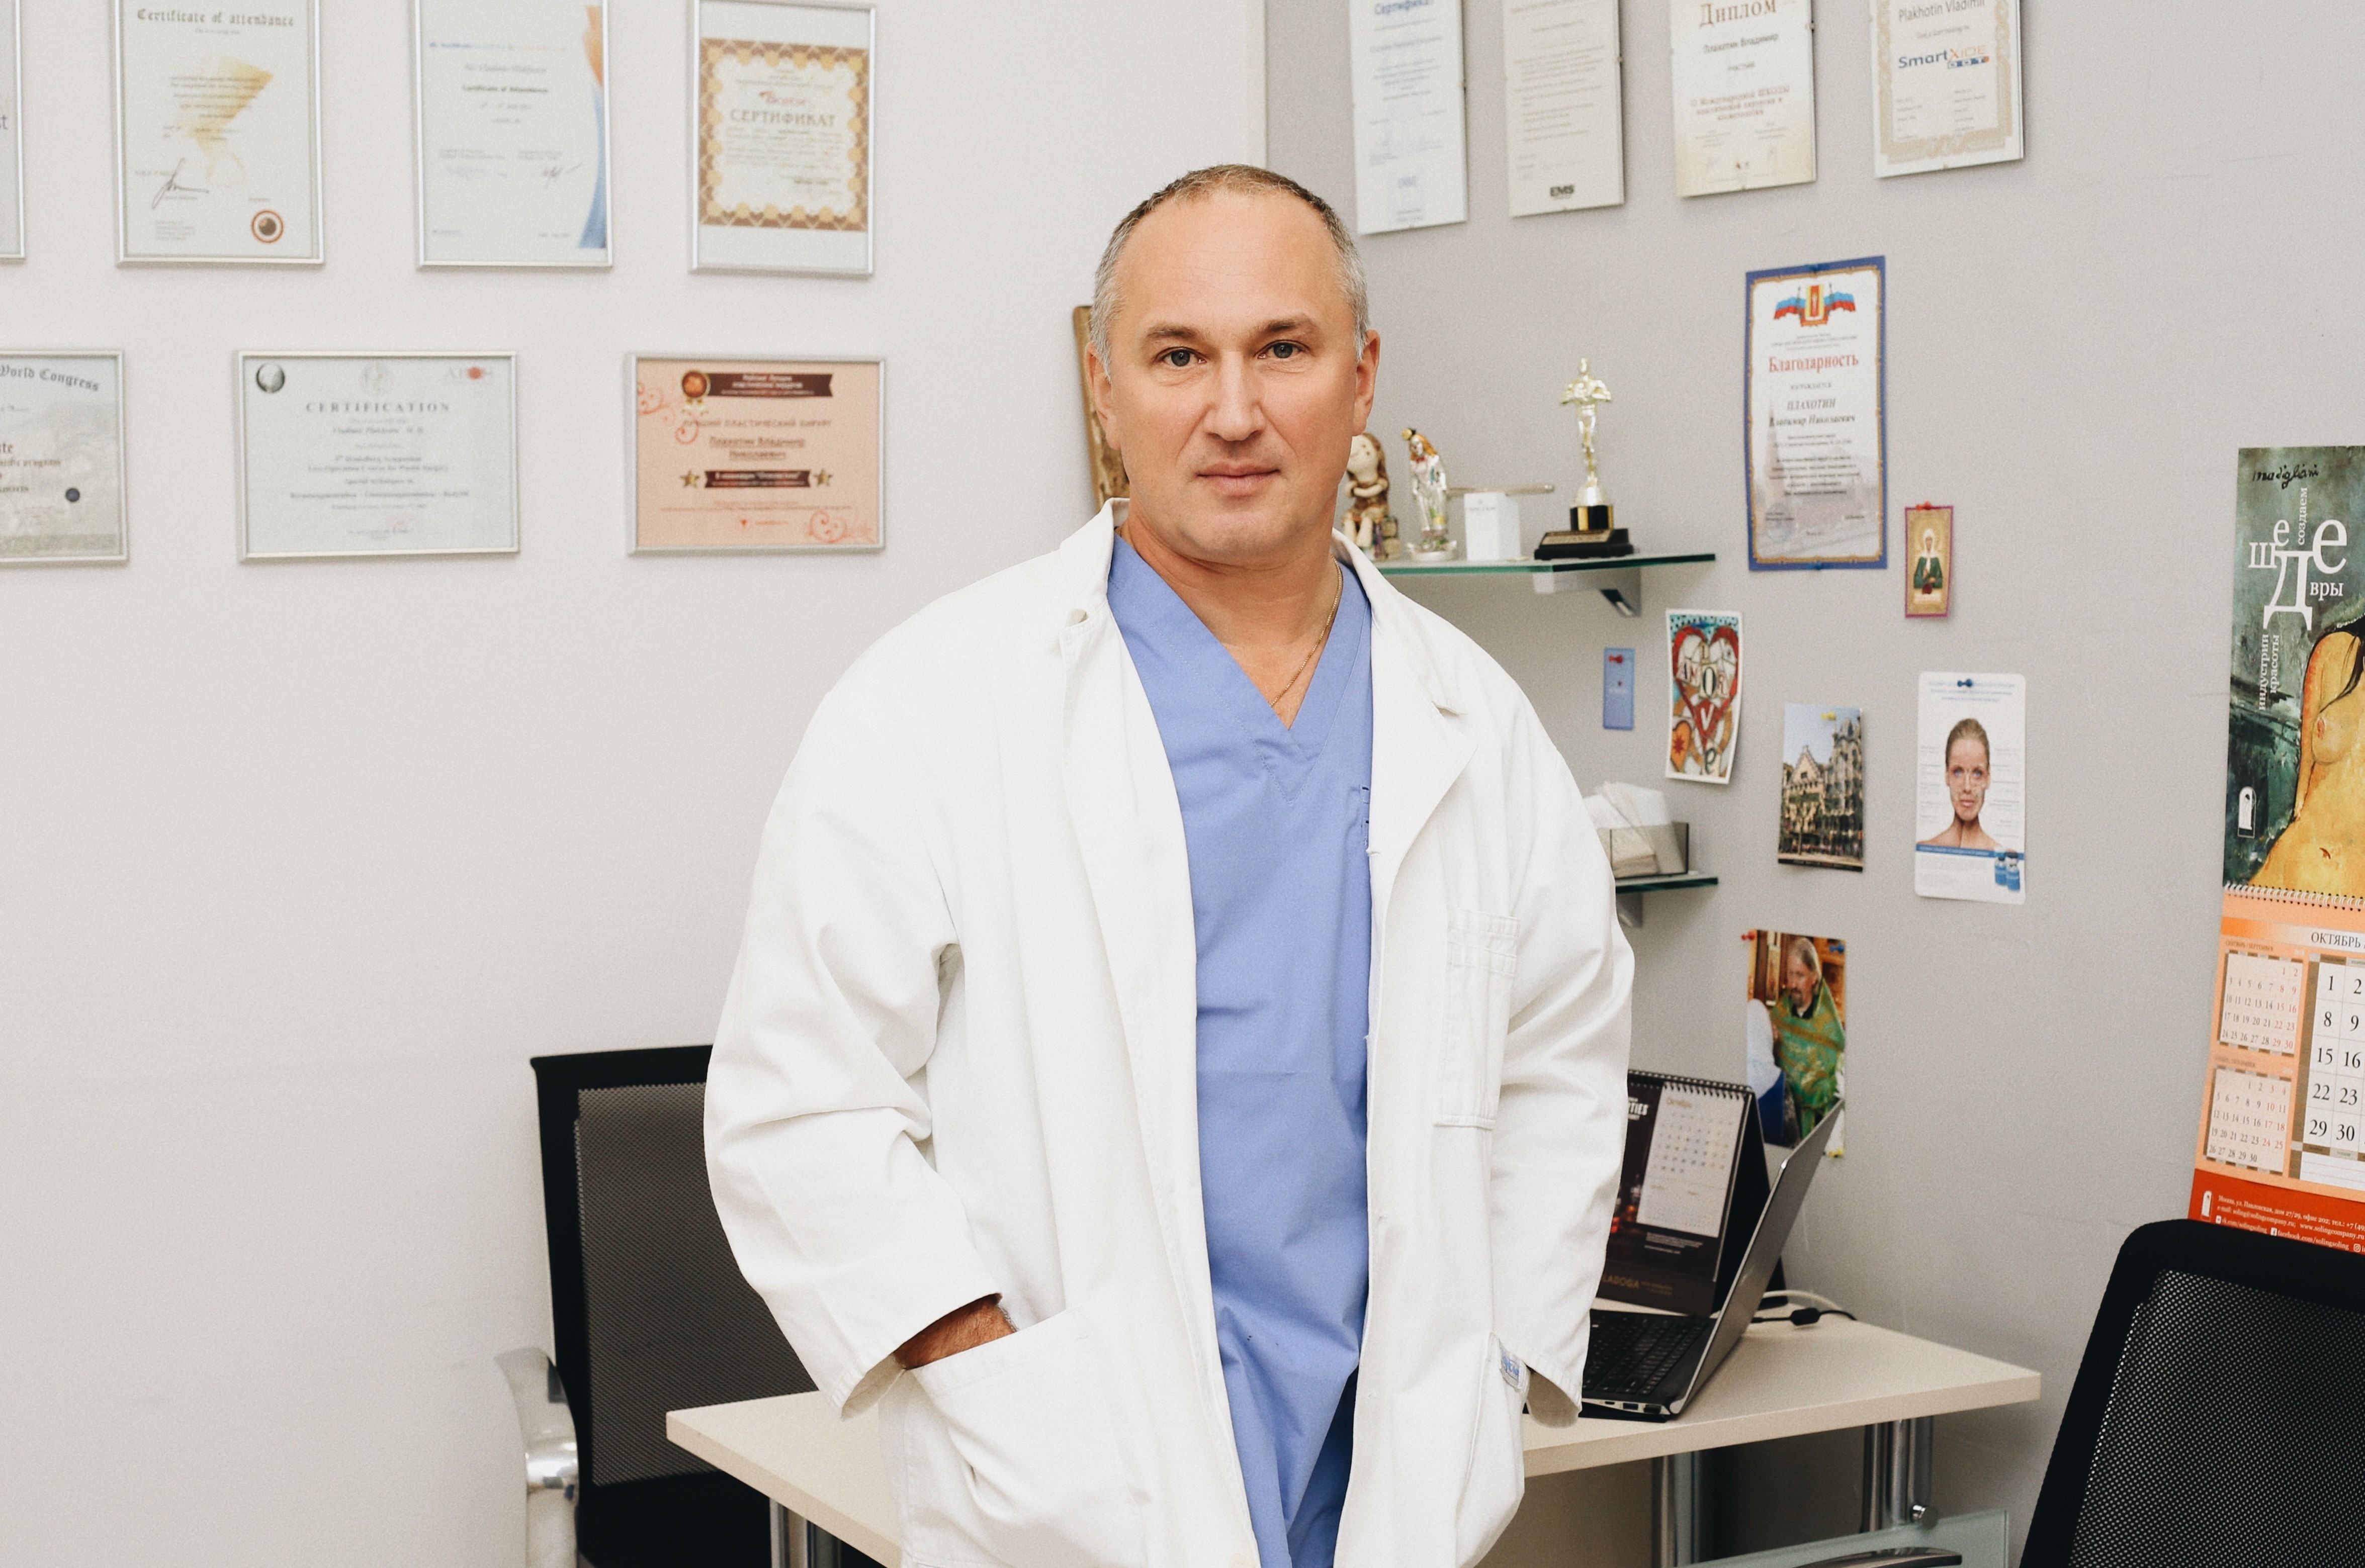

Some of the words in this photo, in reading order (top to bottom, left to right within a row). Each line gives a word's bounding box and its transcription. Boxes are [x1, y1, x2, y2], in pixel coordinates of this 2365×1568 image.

[137, 8, 205, 22] Certificate
[212, 11, 222, 23] of
[230, 14, 294, 26] attendance
[1699, 0, 1776, 29] Диплом
[1899, 5, 1943, 21] Plakhotin
[1946, 0, 1985, 13] Vladimir
[730, 109, 836, 126] СЕРТИФИКАТ
[1550, 184, 1574, 197] EMS
[1769, 354, 1859, 374] Благодарность
[39, 368, 100, 391] Congress
[306, 403, 450, 413] CERTIFICATION
[2298, 487, 2308, 545] создаем
[2259, 634, 2269, 710] индустрии
[2270, 634, 2280, 694] красоты
[2311, 932, 2360, 948] ОКТЯБРЬ
[2294, 969, 2298, 977] 2
[2280, 985, 2284, 993] 8
[2292, 986, 2297, 995] 9
[2329, 975, 2333, 990] 1
[2353, 979, 2361, 994] 2
[2226, 994, 2232, 1003] 10
[2235, 996, 2241, 1004] 11
[2245, 998, 2251, 1006] 12
[2255, 999, 2262, 1007] 13
[2266, 1001, 2273, 1009] 14
[2277, 1002, 2285, 1011] 15
[2289, 1004, 2297, 1013] 16
[2233, 1014, 2239, 1022] 18
[2243, 1016, 2249, 1024] 19
[2252, 1017, 2260, 1025] 20
[2263, 1019, 2271, 1027] 21
[2274, 1021, 2283, 1029] 22
[2287, 1023, 2295, 1031] 23
[2324, 1011, 2332, 1027] 8
[2350, 1015, 2359, 1032] 9
[2222, 1030, 2228, 1038] 24
[2231, 1032, 2237, 1040] 25
[2240, 1033, 2247, 1041] 26
[2250, 1035, 2258, 1043] 27
[2262, 1036, 2269, 1045] 28
[2272, 1038, 2281, 1047] 29
[2285, 1040, 2293, 1049] 30
[2318, 1047, 2333, 1065] 15
[2344, 1051, 2361, 1068] 16
[2248, 1081, 2251, 1089] 1
[2258, 1083, 2262, 1091] 2
[2270, 1084, 2274, 1093] 3
[2282, 1087, 2286, 1095] 4
[2312, 1083, 2330, 1100] 22
[2340, 1087, 2357, 1105] 23
[1628, 1101, 1649, 1116] TIES
[2226, 1094, 2229, 1102] 6
[2236, 1096, 2239, 1104] 7
[2246, 1098, 2250, 1106] 8
[2267, 1102, 2274, 1111] 10
[2279, 1104, 2286, 1113] 11
[2214, 1110, 2220, 1119] 12
[2223, 1112, 2229, 1121] 13
[2232, 1114, 2238, 1123] 14
[2243, 1116, 2250, 1125] 15
[2254, 1118, 2261, 1127] 16
[2277, 1123, 2285, 1131] 18
[2309, 1119, 2327, 1137] 29
[2336, 1124, 2354, 1141] 30
[2212, 1128, 2218, 1136] 19
[2220, 1130, 2227, 1138] 20
[2230, 1132, 2237, 1140] 21
[2240, 1134, 2248, 1143] 22
[2251, 1136, 2259, 1145] 23
[2262, 1138, 2270, 1147] 24
[2275, 1141, 2283, 1149] 25
[2209, 1145, 2216, 1153] 26
[2218, 1147, 2226, 1155] 27
[2228, 1149, 2235, 1157] 28
[2239, 1151, 2246, 1160] 29
[2250, 1153, 2257, 1162] 30
[2286, 1211, 2302, 1220] 27/29,
[2300, 1223, 2364, 1240] www.solingcompany.ru
